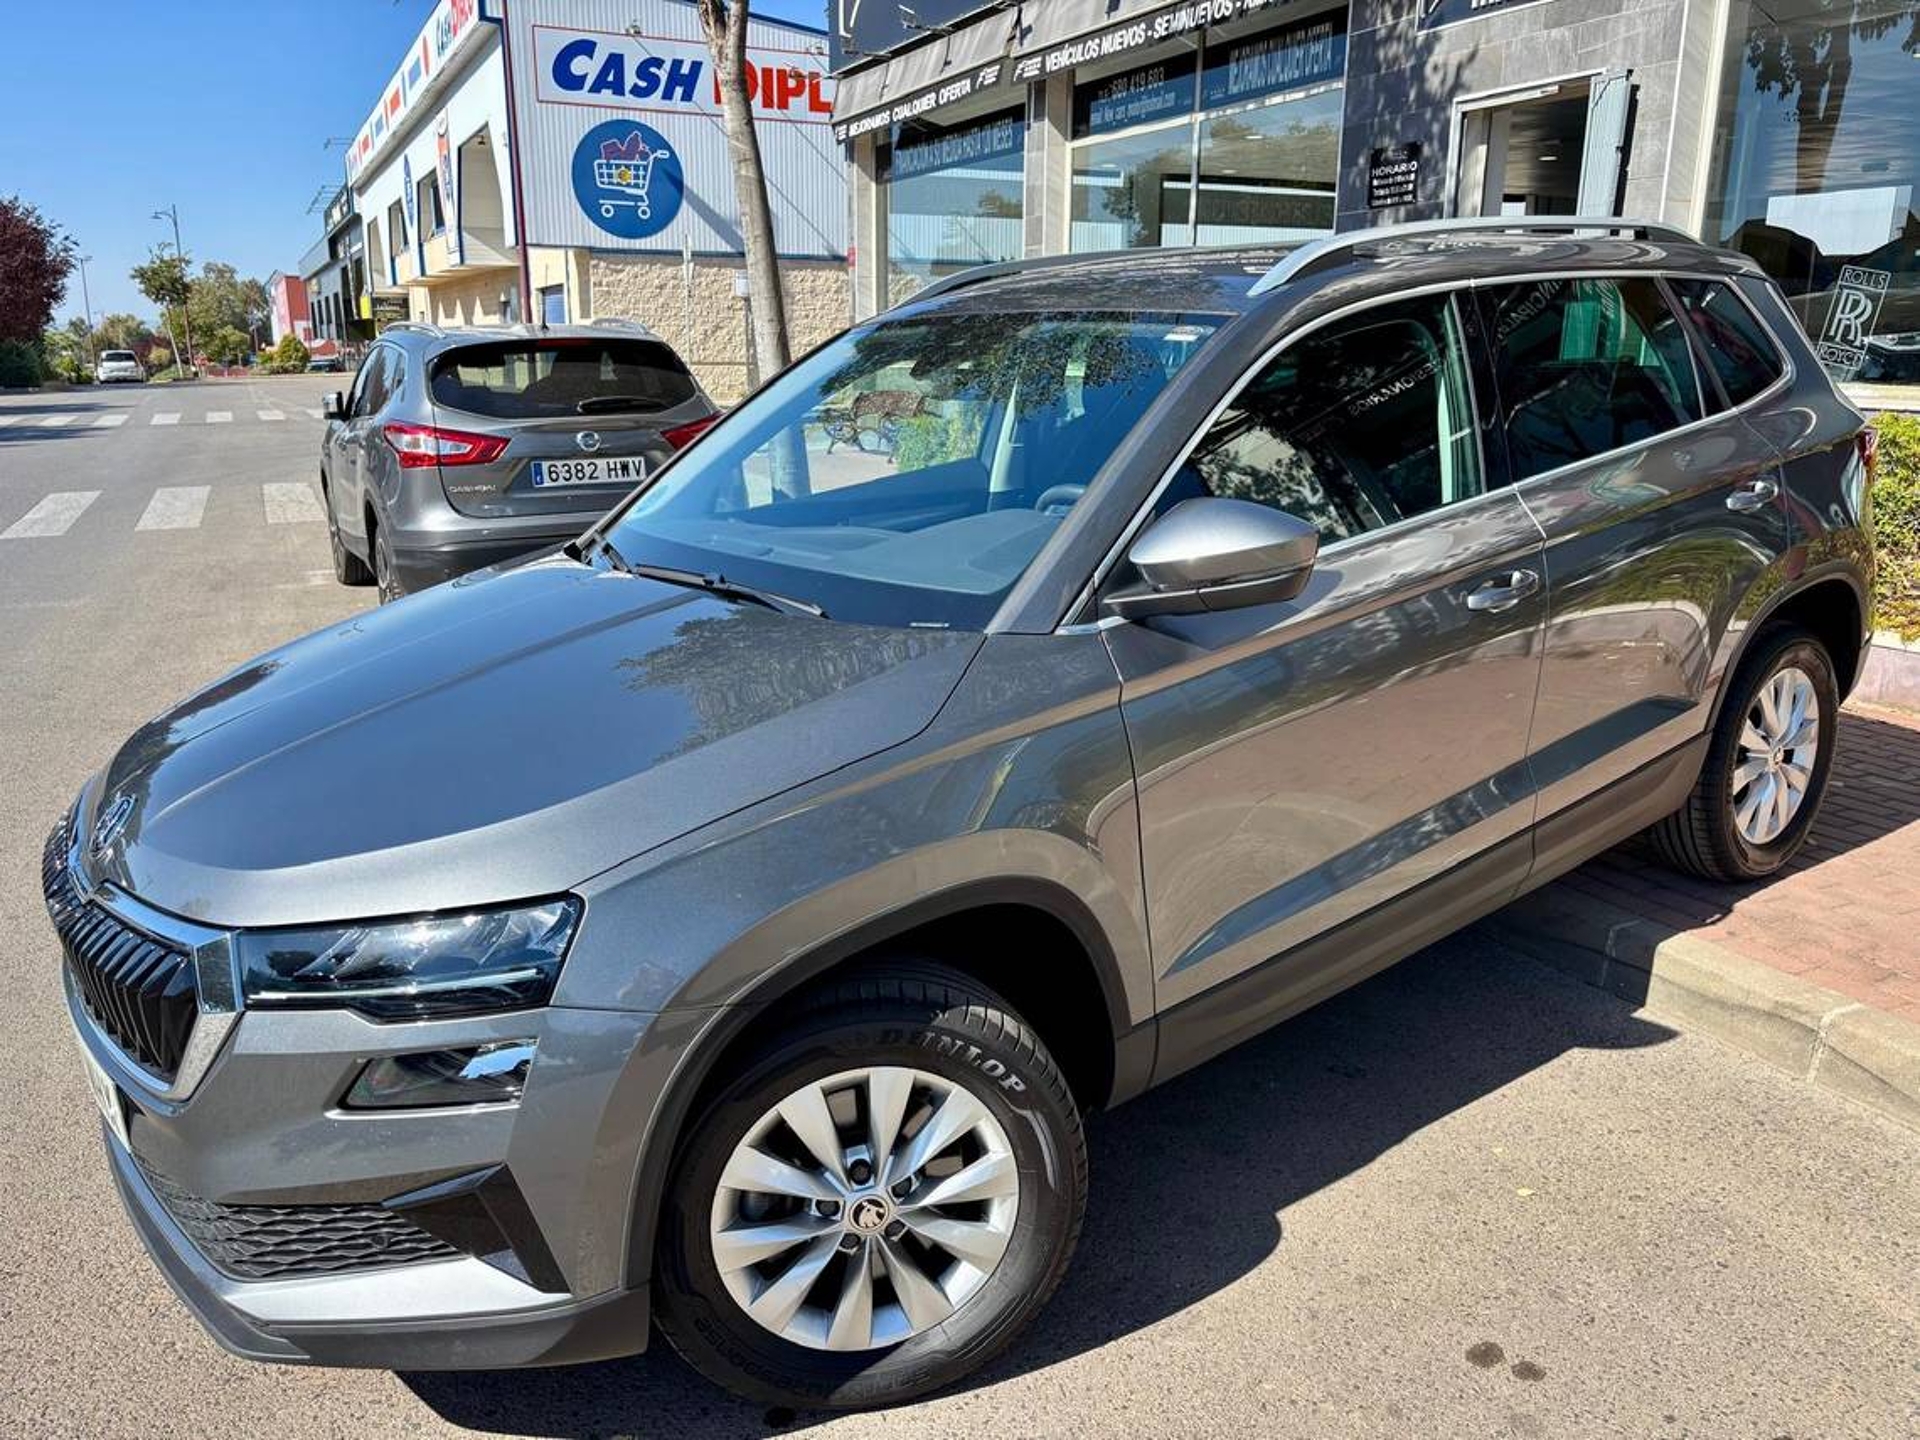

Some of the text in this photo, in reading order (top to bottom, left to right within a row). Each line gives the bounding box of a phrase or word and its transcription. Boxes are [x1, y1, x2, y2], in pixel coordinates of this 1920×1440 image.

[1045, 38, 1100, 73] VEHÍCULOS
[1100, 22, 1146, 56] NUEVOS
[1154, 0, 1233, 39] SEMINUEVOS
[552, 39, 703, 102] CASH
[849, 111, 890, 138] MEJORAMOS
[892, 94, 937, 121] CUALQUIER
[939, 78, 971, 105] OFERTA
[1372, 161, 1418, 177] HORARIO
[1843, 269, 1886, 289] ROLLS
[1820, 345, 1864, 367] ROYCE
[548, 459, 643, 482] 6382 HWV
